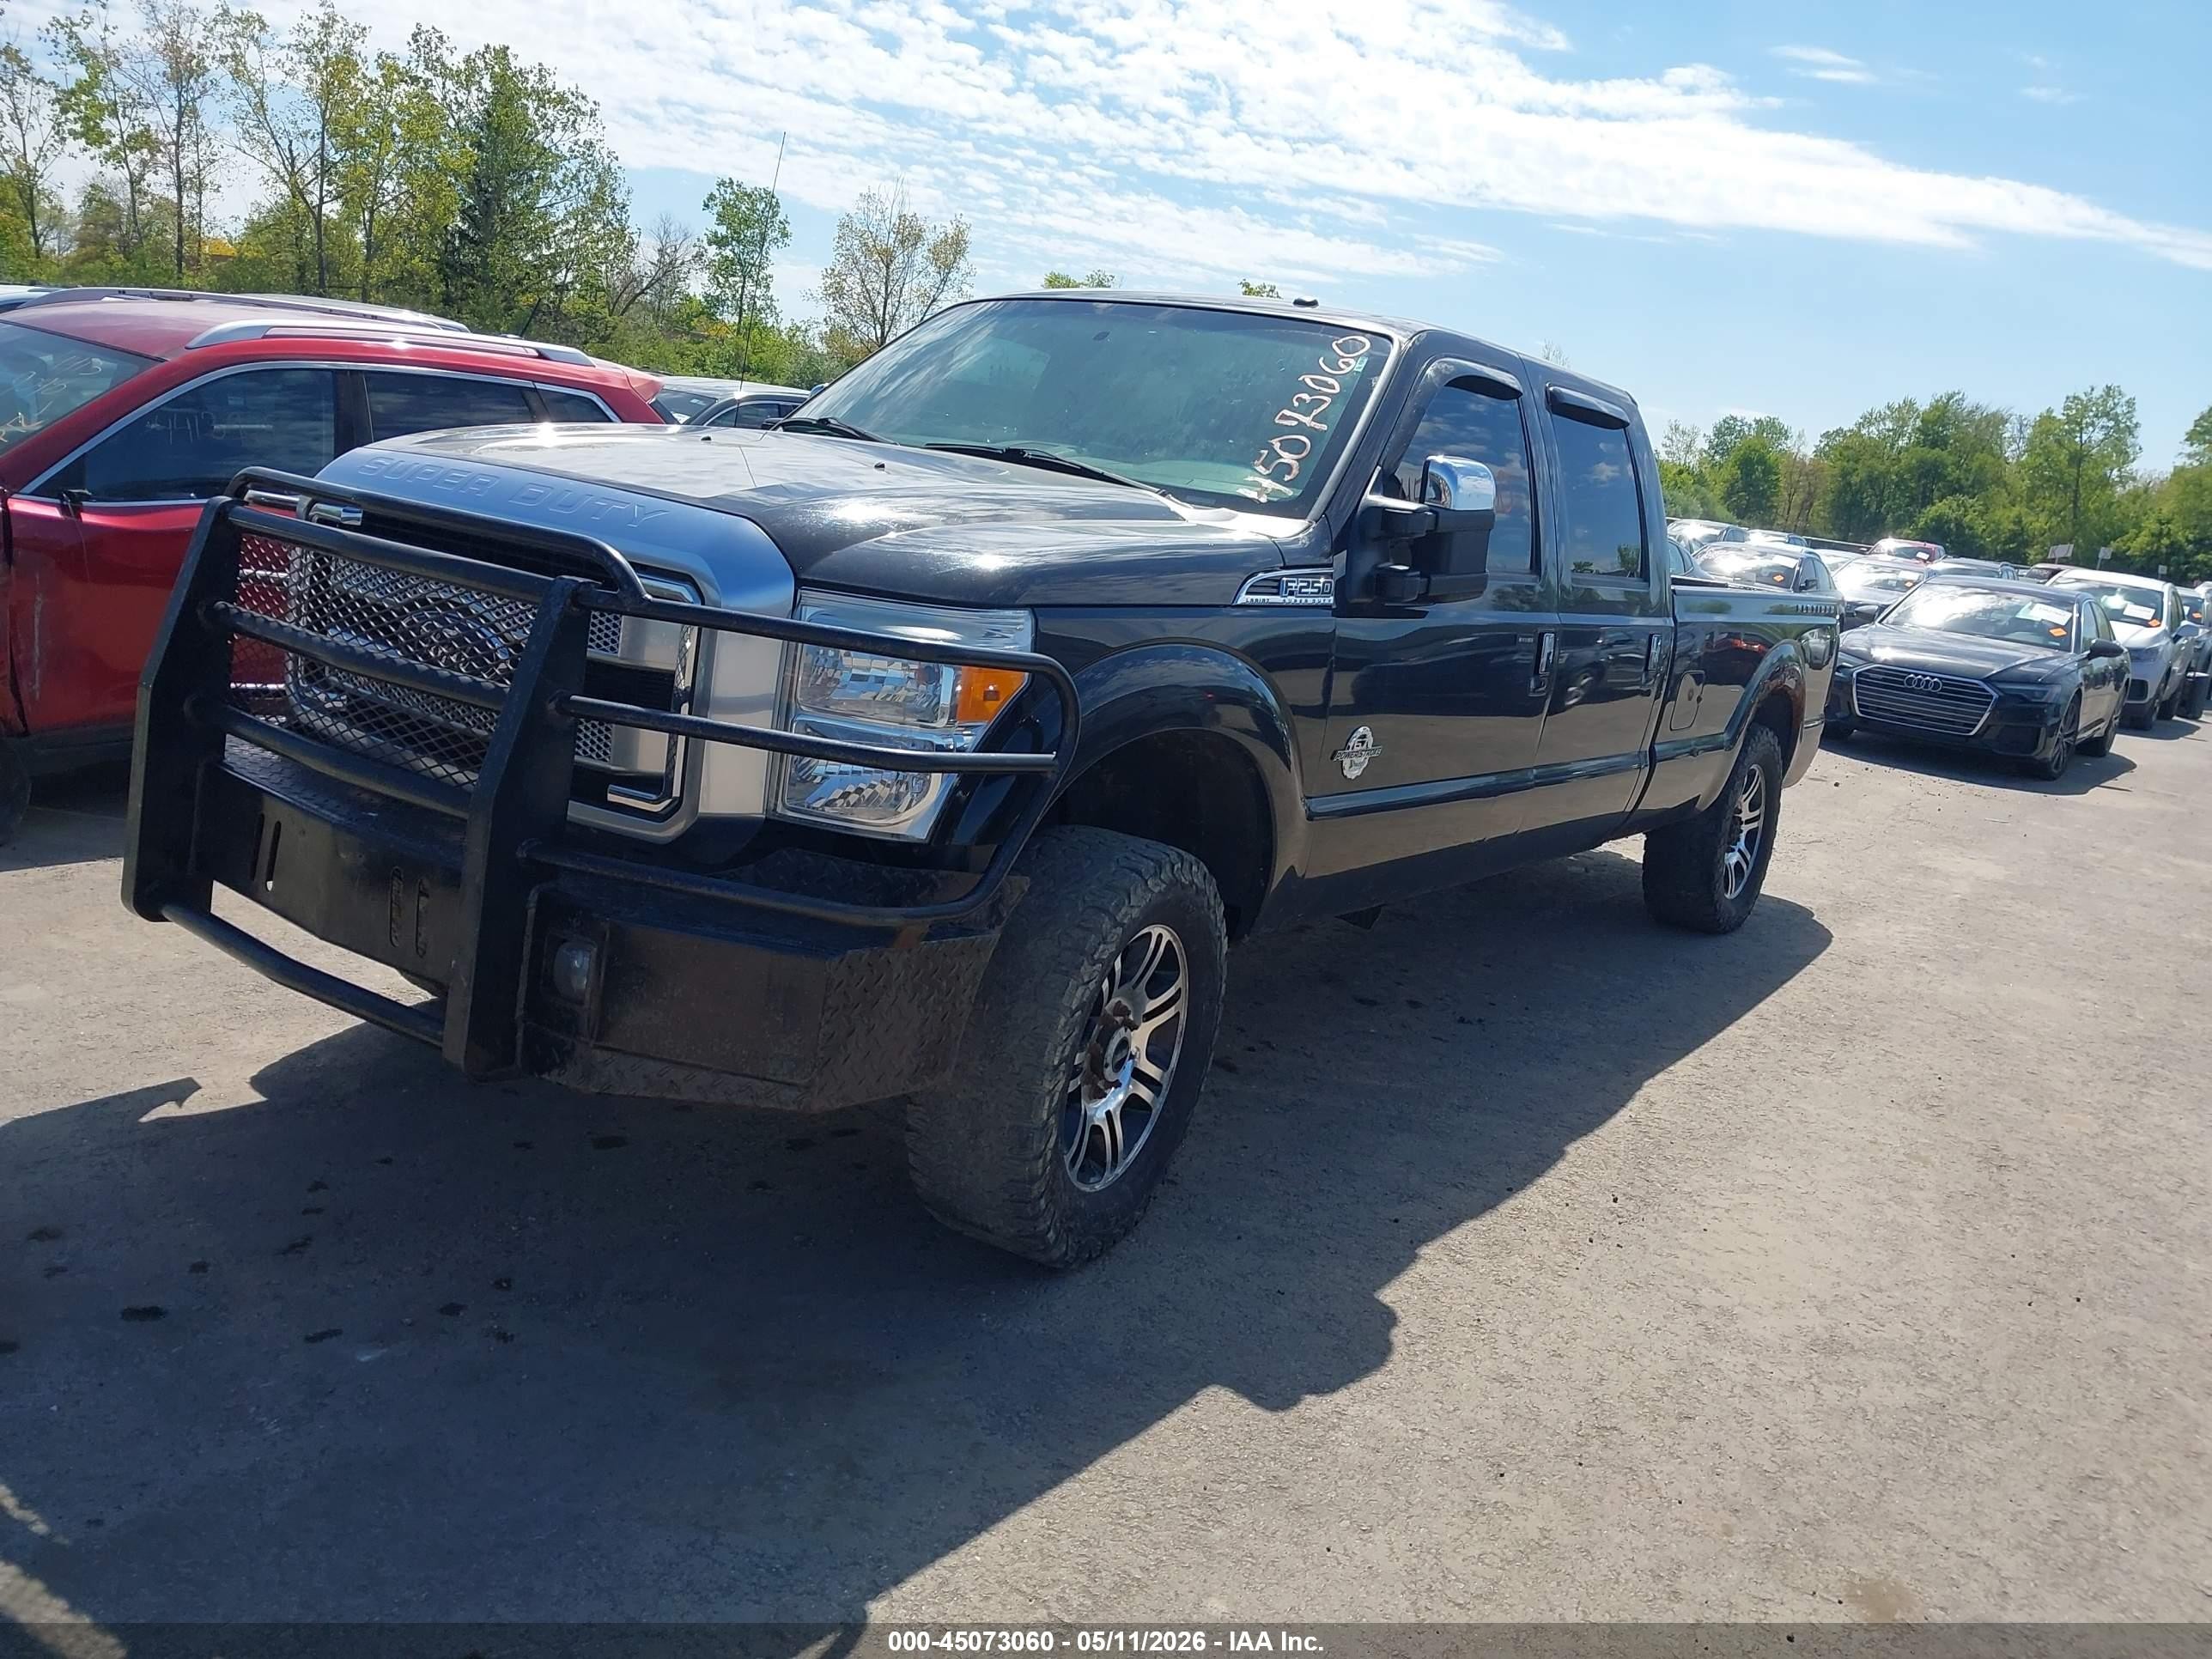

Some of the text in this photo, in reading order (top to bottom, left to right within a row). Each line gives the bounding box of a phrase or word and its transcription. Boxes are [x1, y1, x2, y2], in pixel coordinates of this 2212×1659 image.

[1237, 335, 1371, 504] 45073060
[357, 456, 670, 528] SUPER DUTY
[1279, 577, 1334, 598] F-250
